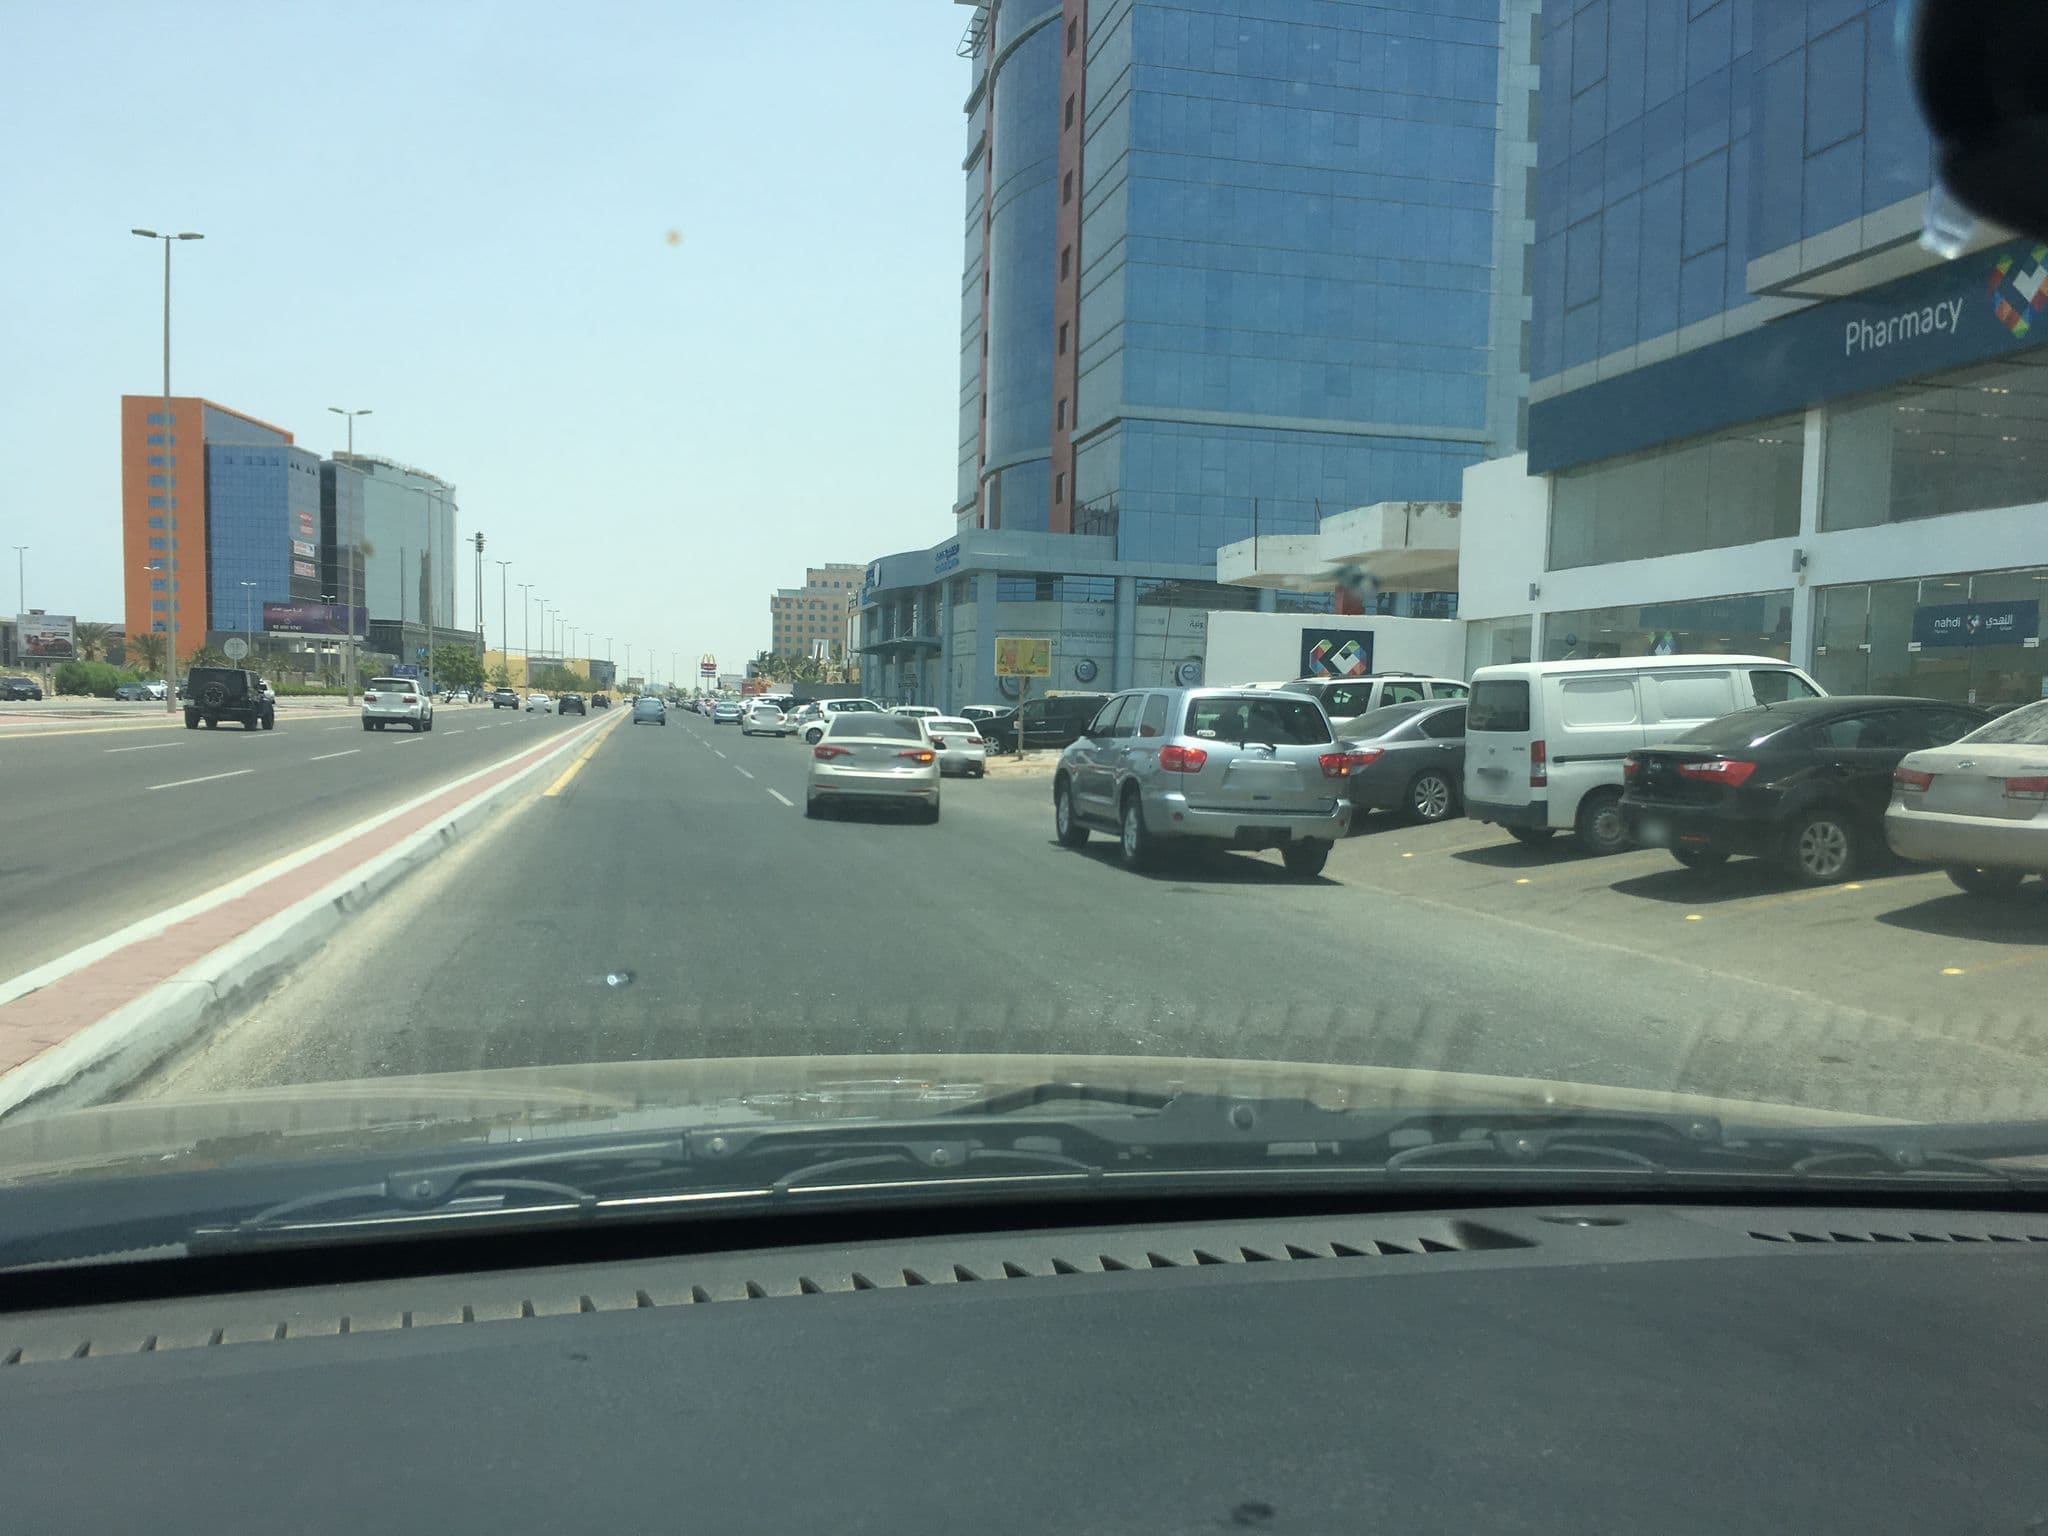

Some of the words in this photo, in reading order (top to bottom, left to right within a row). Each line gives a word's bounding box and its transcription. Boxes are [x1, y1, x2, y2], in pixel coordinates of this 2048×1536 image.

[1845, 297, 1963, 356] Pharmacy
[1934, 616, 1960, 628] nahdi
[1985, 614, 2013, 628] النهدي
